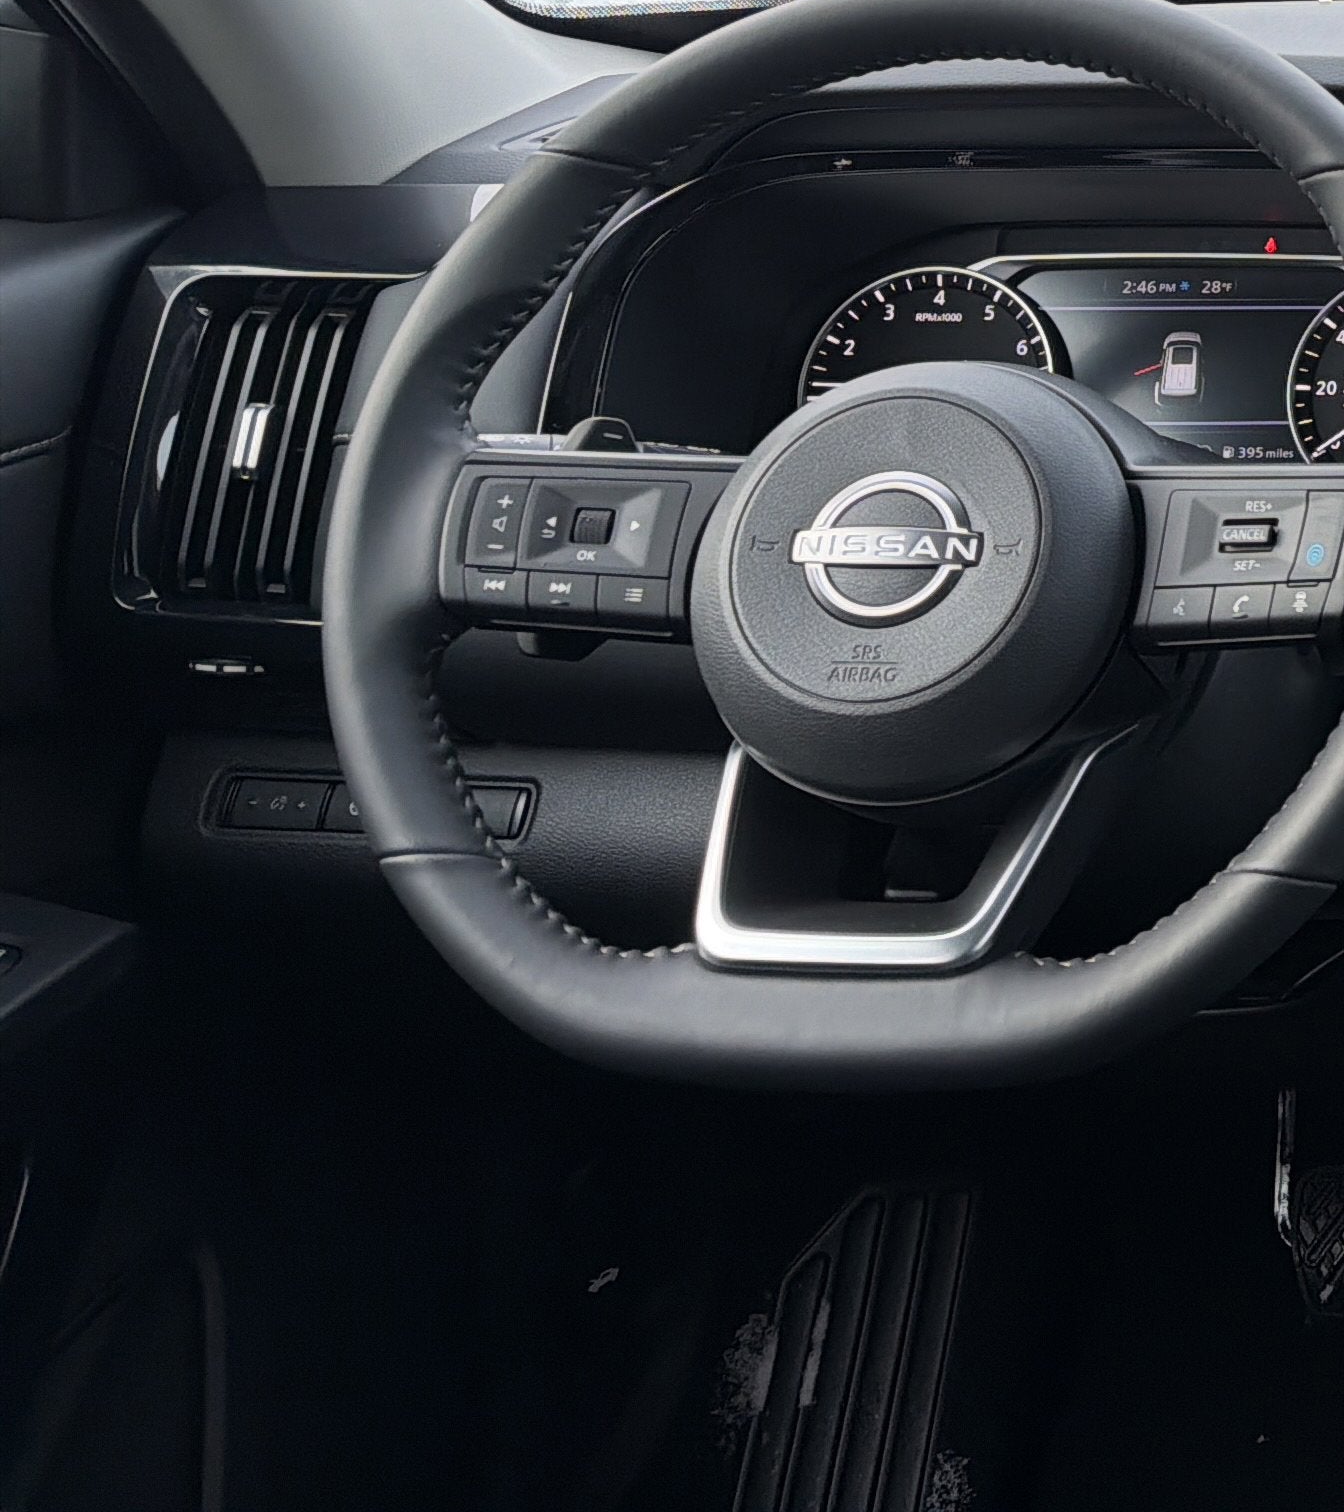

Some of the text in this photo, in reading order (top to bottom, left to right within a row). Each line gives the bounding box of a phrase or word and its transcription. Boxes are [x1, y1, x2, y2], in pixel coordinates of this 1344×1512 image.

[1121, 280, 1233, 295] 2:46 PM 28°F
[933, 290, 946, 306] 4
[883, 304, 895, 321] 3
[915, 312, 962, 323] RPMx1000
[984, 304, 995, 321] 5
[843, 340, 855, 356] 2
[1016, 340, 1028, 356] 6
[1315, 381, 1337, 396] 20
[1237, 447, 1294, 459] 395 miles
[1245, 500, 1273, 513] RES+
[1222, 528, 1266, 540] CANCEL
[799, 534, 978, 561] NISSAN
[576, 550, 597, 562] OK
[851, 644, 882, 660] SRS
[828, 666, 898, 684] AIRBAG
